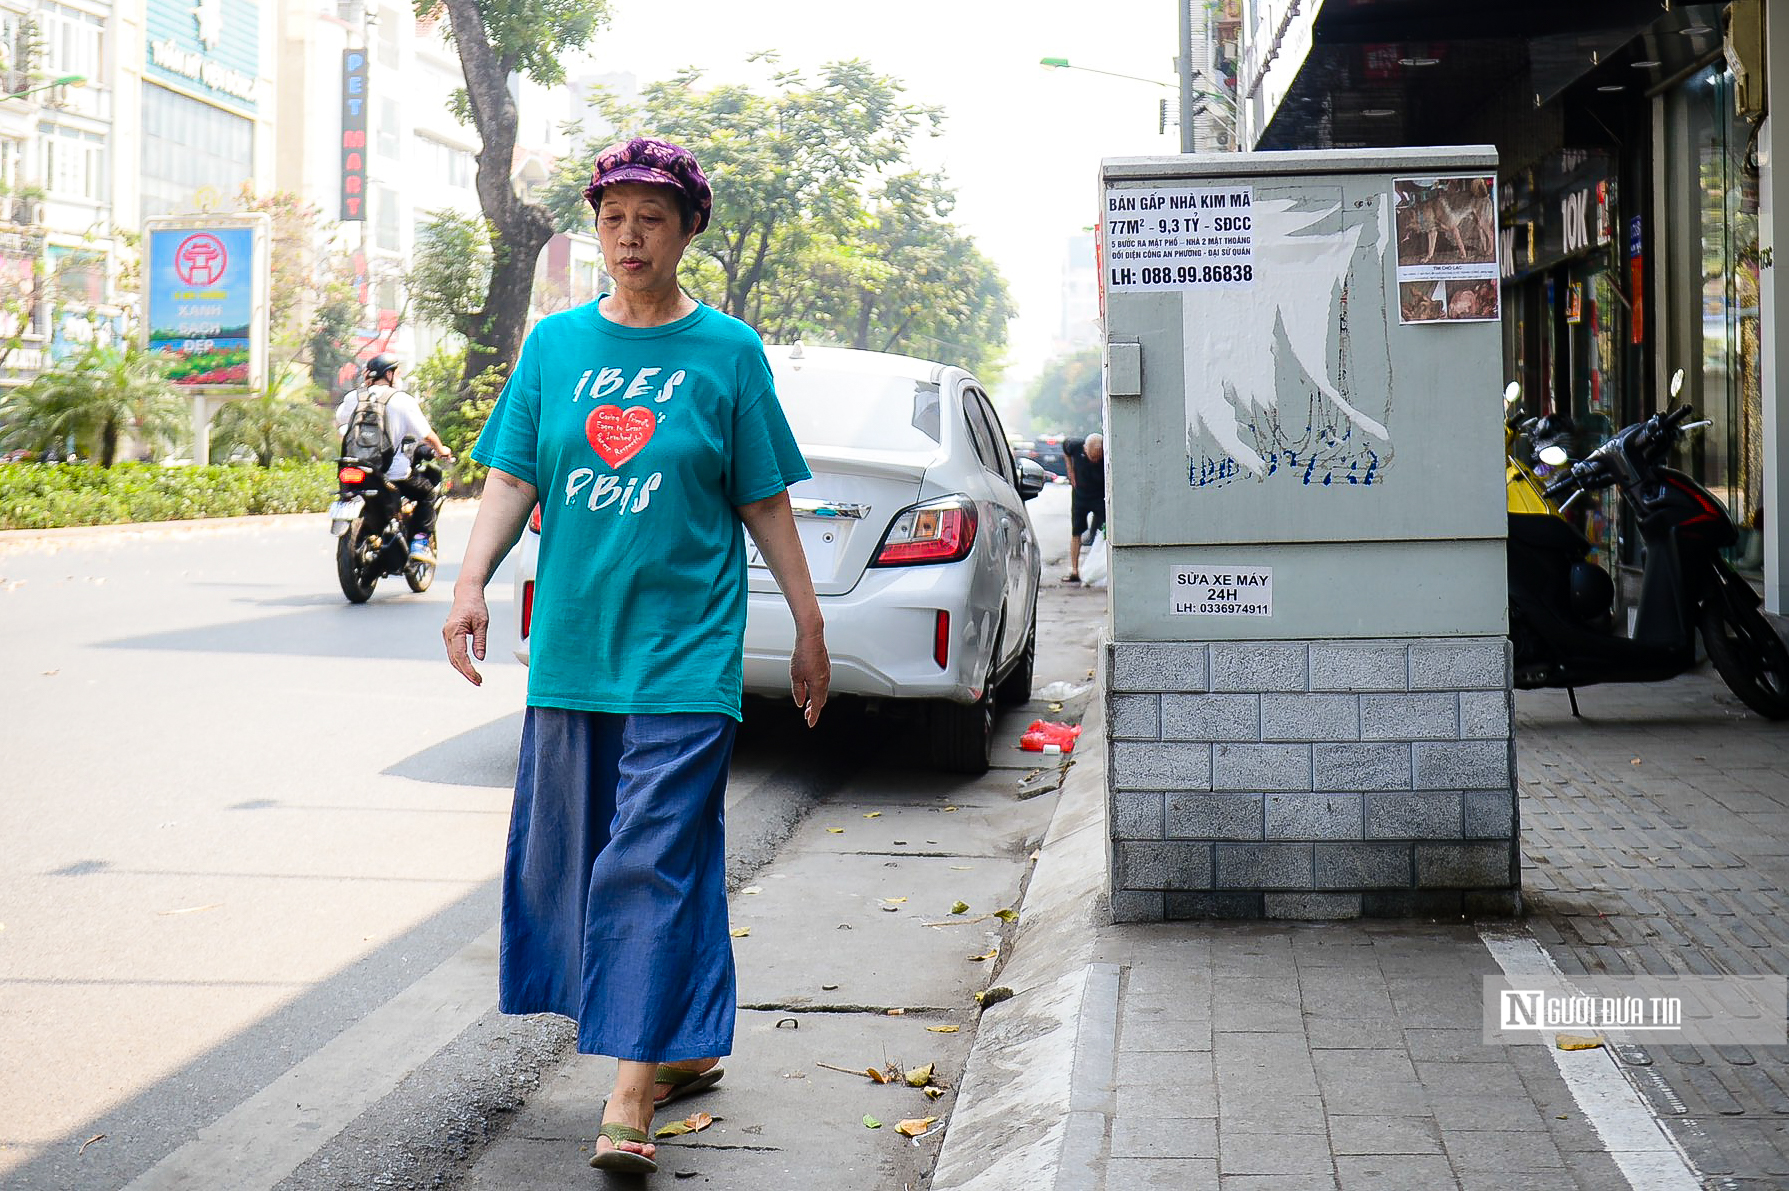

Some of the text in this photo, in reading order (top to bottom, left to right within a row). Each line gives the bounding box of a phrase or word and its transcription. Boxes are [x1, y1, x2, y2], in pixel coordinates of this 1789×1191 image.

[346, 53, 364, 116] PET
[1109, 190, 1251, 211] BÁN GẤP NHÀ KIM MÃ
[1158, 219, 1180, 235] 9,3
[1214, 216, 1252, 232] SĐCC
[1561, 188, 1589, 254] 10K
[1111, 240, 1116, 248] 5
[1137, 240, 1147, 248] RA
[1186, 237, 1201, 246] NHÀ
[1201, 238, 1207, 246] 2
[1163, 250, 1173, 258] AN
[1500, 226, 1515, 279] 0K
[1111, 264, 1253, 285] LH: 088.99.86838
[1177, 571, 1269, 587] SỬA XE MÁY
[1207, 588, 1238, 601] 24H
[1176, 602, 1268, 615] LH: 0336974911
